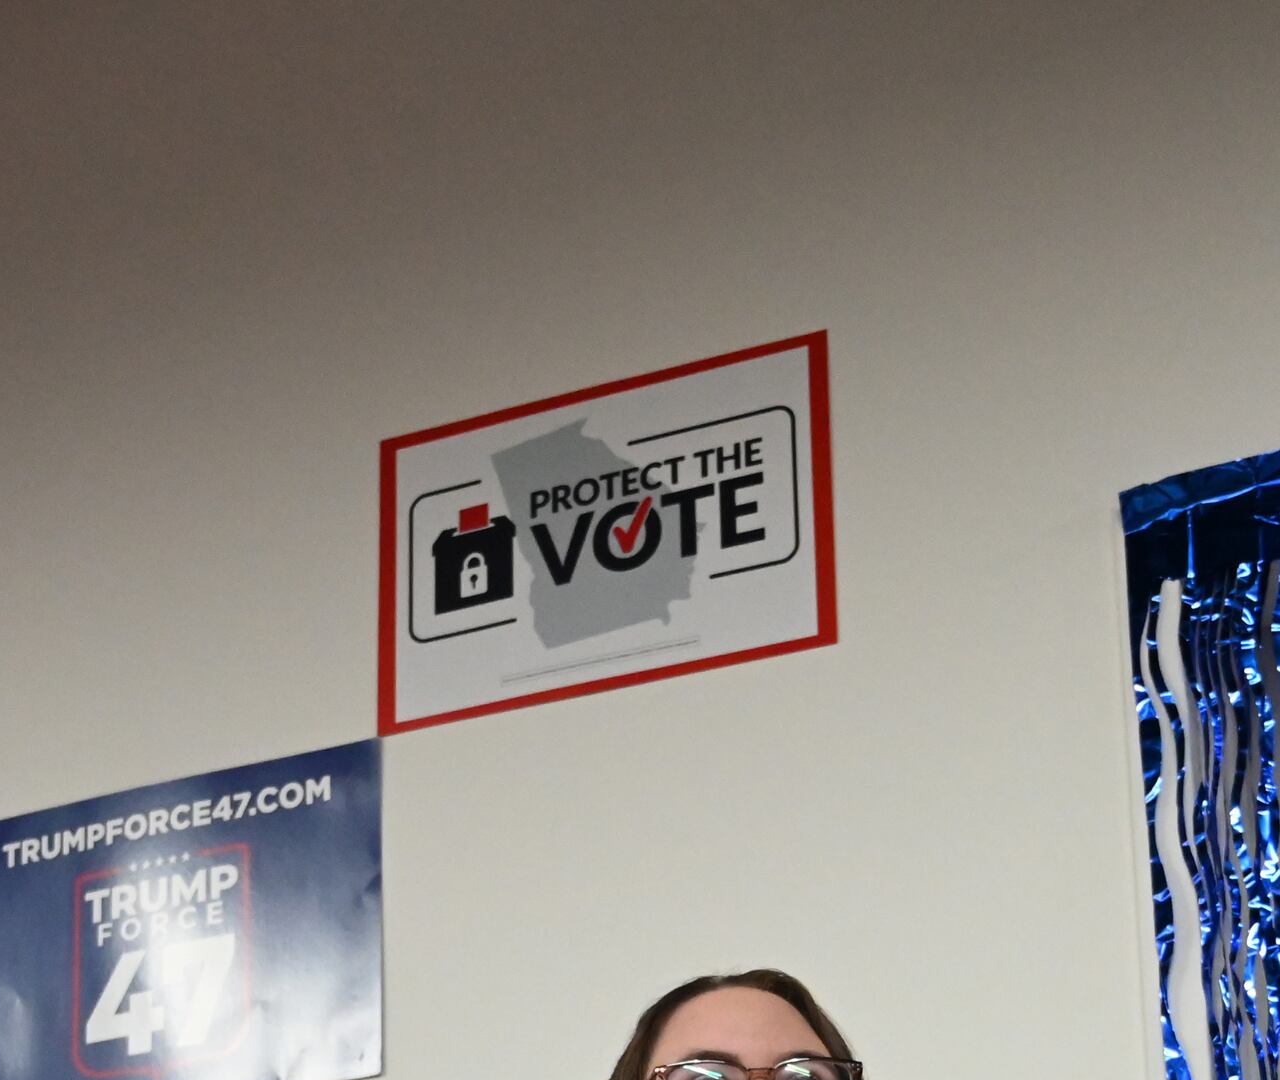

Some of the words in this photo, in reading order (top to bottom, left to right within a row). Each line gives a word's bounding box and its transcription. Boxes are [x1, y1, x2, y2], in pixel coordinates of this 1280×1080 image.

[529, 455, 685, 519] PROTECT
[694, 437, 763, 479] THE
[530, 472, 766, 587] VOTE
[2, 775, 331, 868] TRUMPFORCE47.COM
[85, 863, 238, 923] TRUMP
[97, 900, 223, 947] FORCE
[86, 933, 235, 1056] 47
